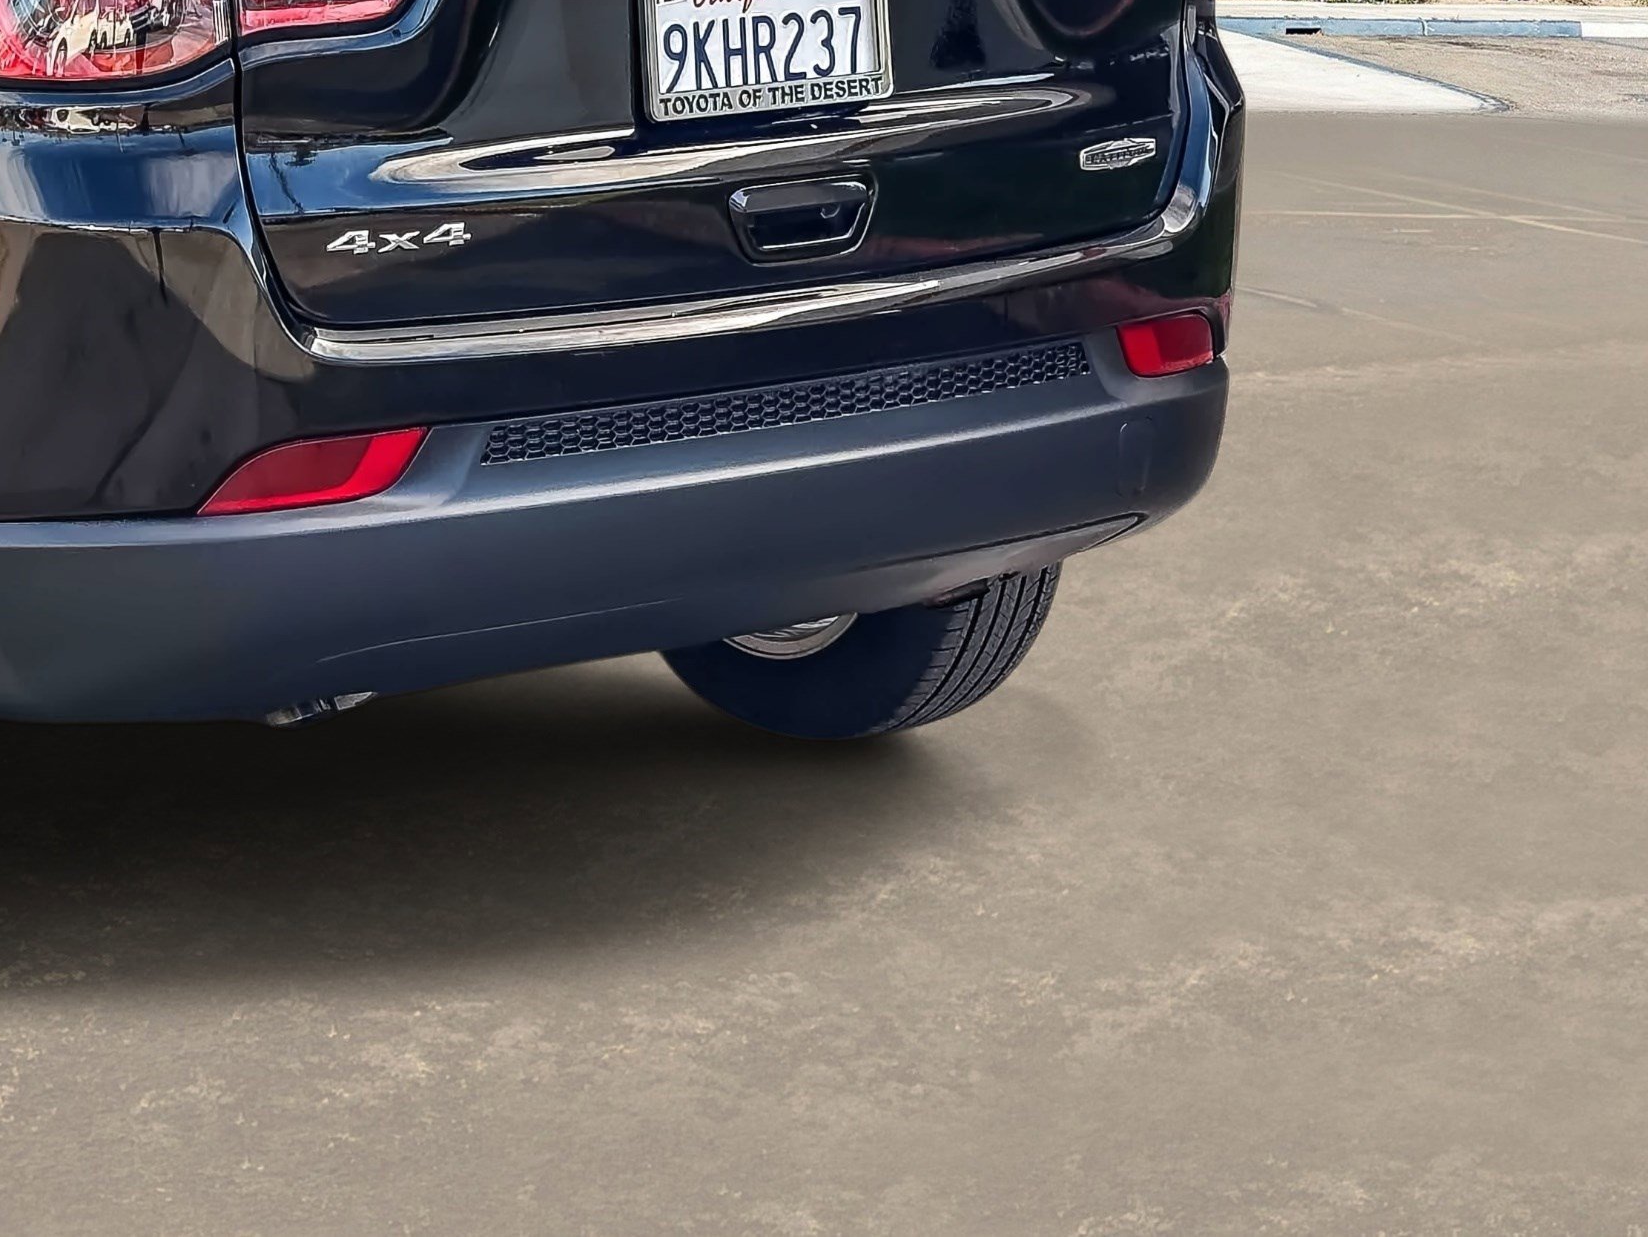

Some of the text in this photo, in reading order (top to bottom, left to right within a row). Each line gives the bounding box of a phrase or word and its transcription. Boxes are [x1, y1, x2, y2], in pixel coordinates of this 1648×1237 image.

[663, 6, 861, 93] 9KHR237
[659, 76, 883, 117] TOYOTA OF THE DESERT
[326, 222, 472, 254] 4x4
